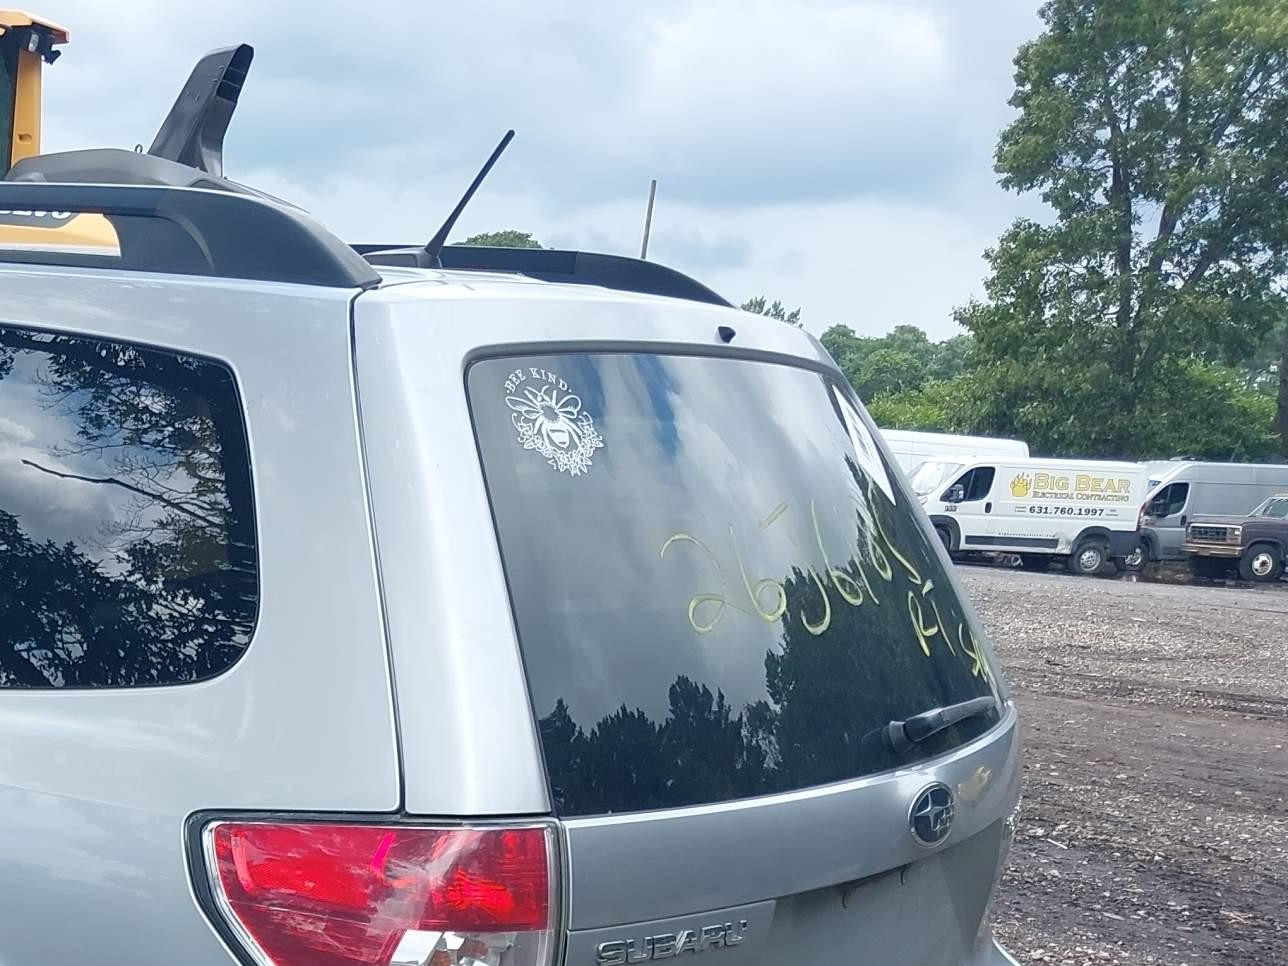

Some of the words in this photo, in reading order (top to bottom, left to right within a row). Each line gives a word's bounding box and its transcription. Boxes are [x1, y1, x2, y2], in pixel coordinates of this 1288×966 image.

[505, 369, 526, 393] BEE
[529, 367, 569, 391] KIND
[1034, 472, 1070, 491] BIG
[1075, 474, 1131, 494] BEAR
[1029, 505, 1105, 517] 631.760.1997
[596, 920, 750, 966] SUBARU
